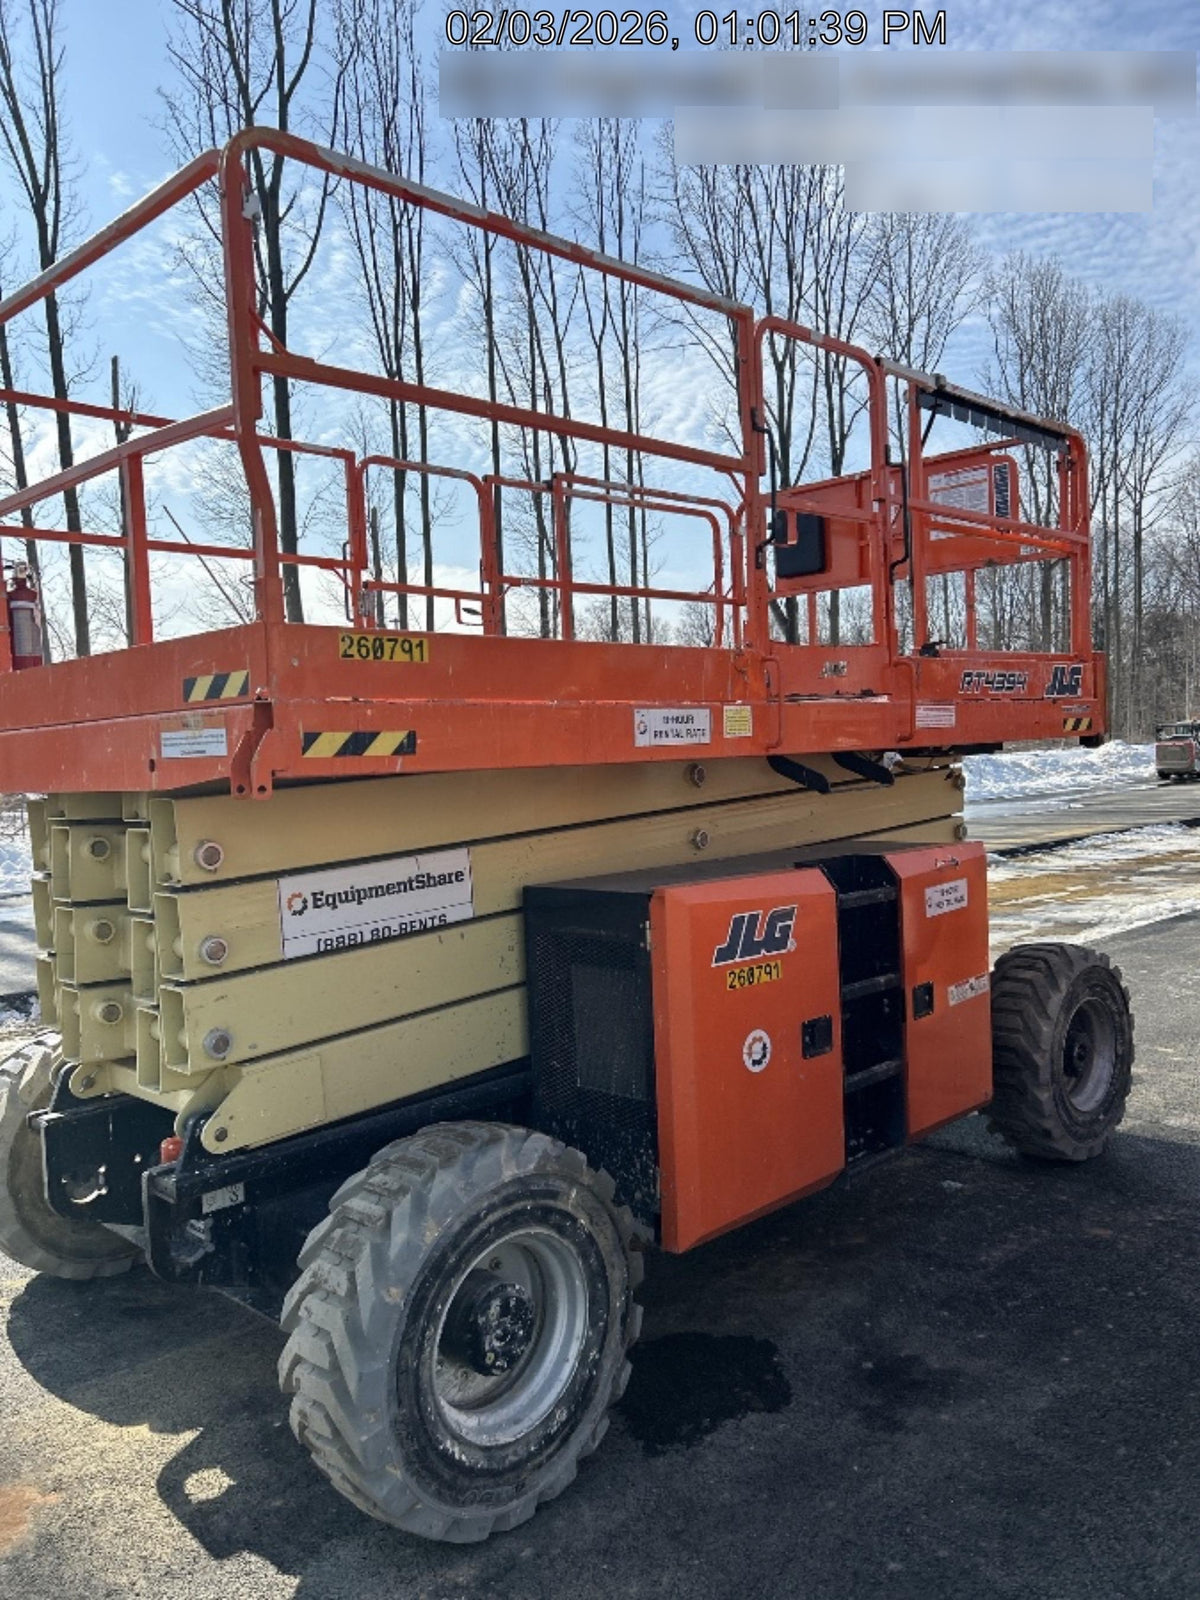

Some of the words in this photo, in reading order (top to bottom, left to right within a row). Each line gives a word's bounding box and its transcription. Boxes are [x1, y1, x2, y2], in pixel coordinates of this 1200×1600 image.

[340, 634, 425, 662] 260791
[958, 670, 1028, 694] RT4394
[1044, 664, 1083, 698] JLG
[311, 869, 465, 910] EquipmentShare
[711, 904, 798, 968] JLG
[728, 962, 780, 990] 260791
